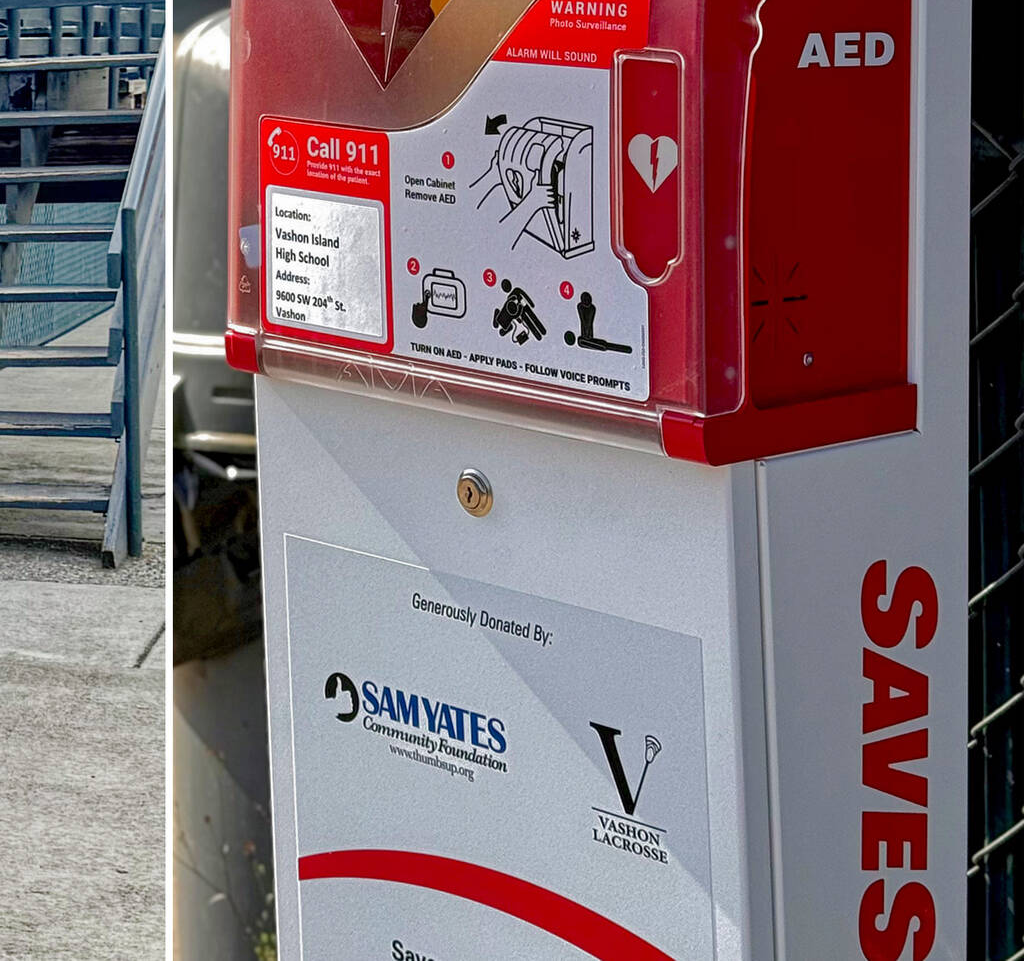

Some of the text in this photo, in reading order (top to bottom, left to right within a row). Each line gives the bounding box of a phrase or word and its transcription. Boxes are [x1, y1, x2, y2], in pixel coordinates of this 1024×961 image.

[551, 0, 627, 17] WARNING
[550, 18, 627, 31] Photo Surveillance
[506, 47, 597, 63] ALARM WILL SOUND
[797, 32, 895, 68] AED
[273, 144, 295, 161] 911
[307, 136, 378, 165] Call 911
[307, 160, 381, 177] Provide 911 with the exact
[330, 172, 336, 181] of
[337, 173, 346, 182] the
[405, 175, 455, 190] Open Cabinet
[405, 189, 456, 204] Remove AED
[275, 207, 311, 222] Location:
[275, 228, 340, 249] Vashon Island
[276, 247, 329, 267] High School
[276, 270, 310, 285] Address:
[276, 290, 295, 303] 9600
[297, 294, 310, 305] SW
[335, 301, 346, 312] St.
[276, 307, 306, 321] Vashon
[410, 342, 432, 354] TURN
[433, 346, 445, 357] ON
[446, 348, 462, 359] AED
[469, 353, 494, 365] APPLY
[496, 357, 517, 370] PADS
[525, 363, 559, 378] FOLLOW
[560, 369, 586, 383] VOICE
[587, 373, 630, 391] PROMPTS
[412, 593, 553, 647] Generously Donated By:
[361, 681, 507, 754] SAM YATES
[363, 715, 508, 773] Community Foundation
[389, 744, 475, 782] www.thumbsup.org
[598, 816, 660, 846] VASHON
[592, 828, 668, 864] LACROSSE
